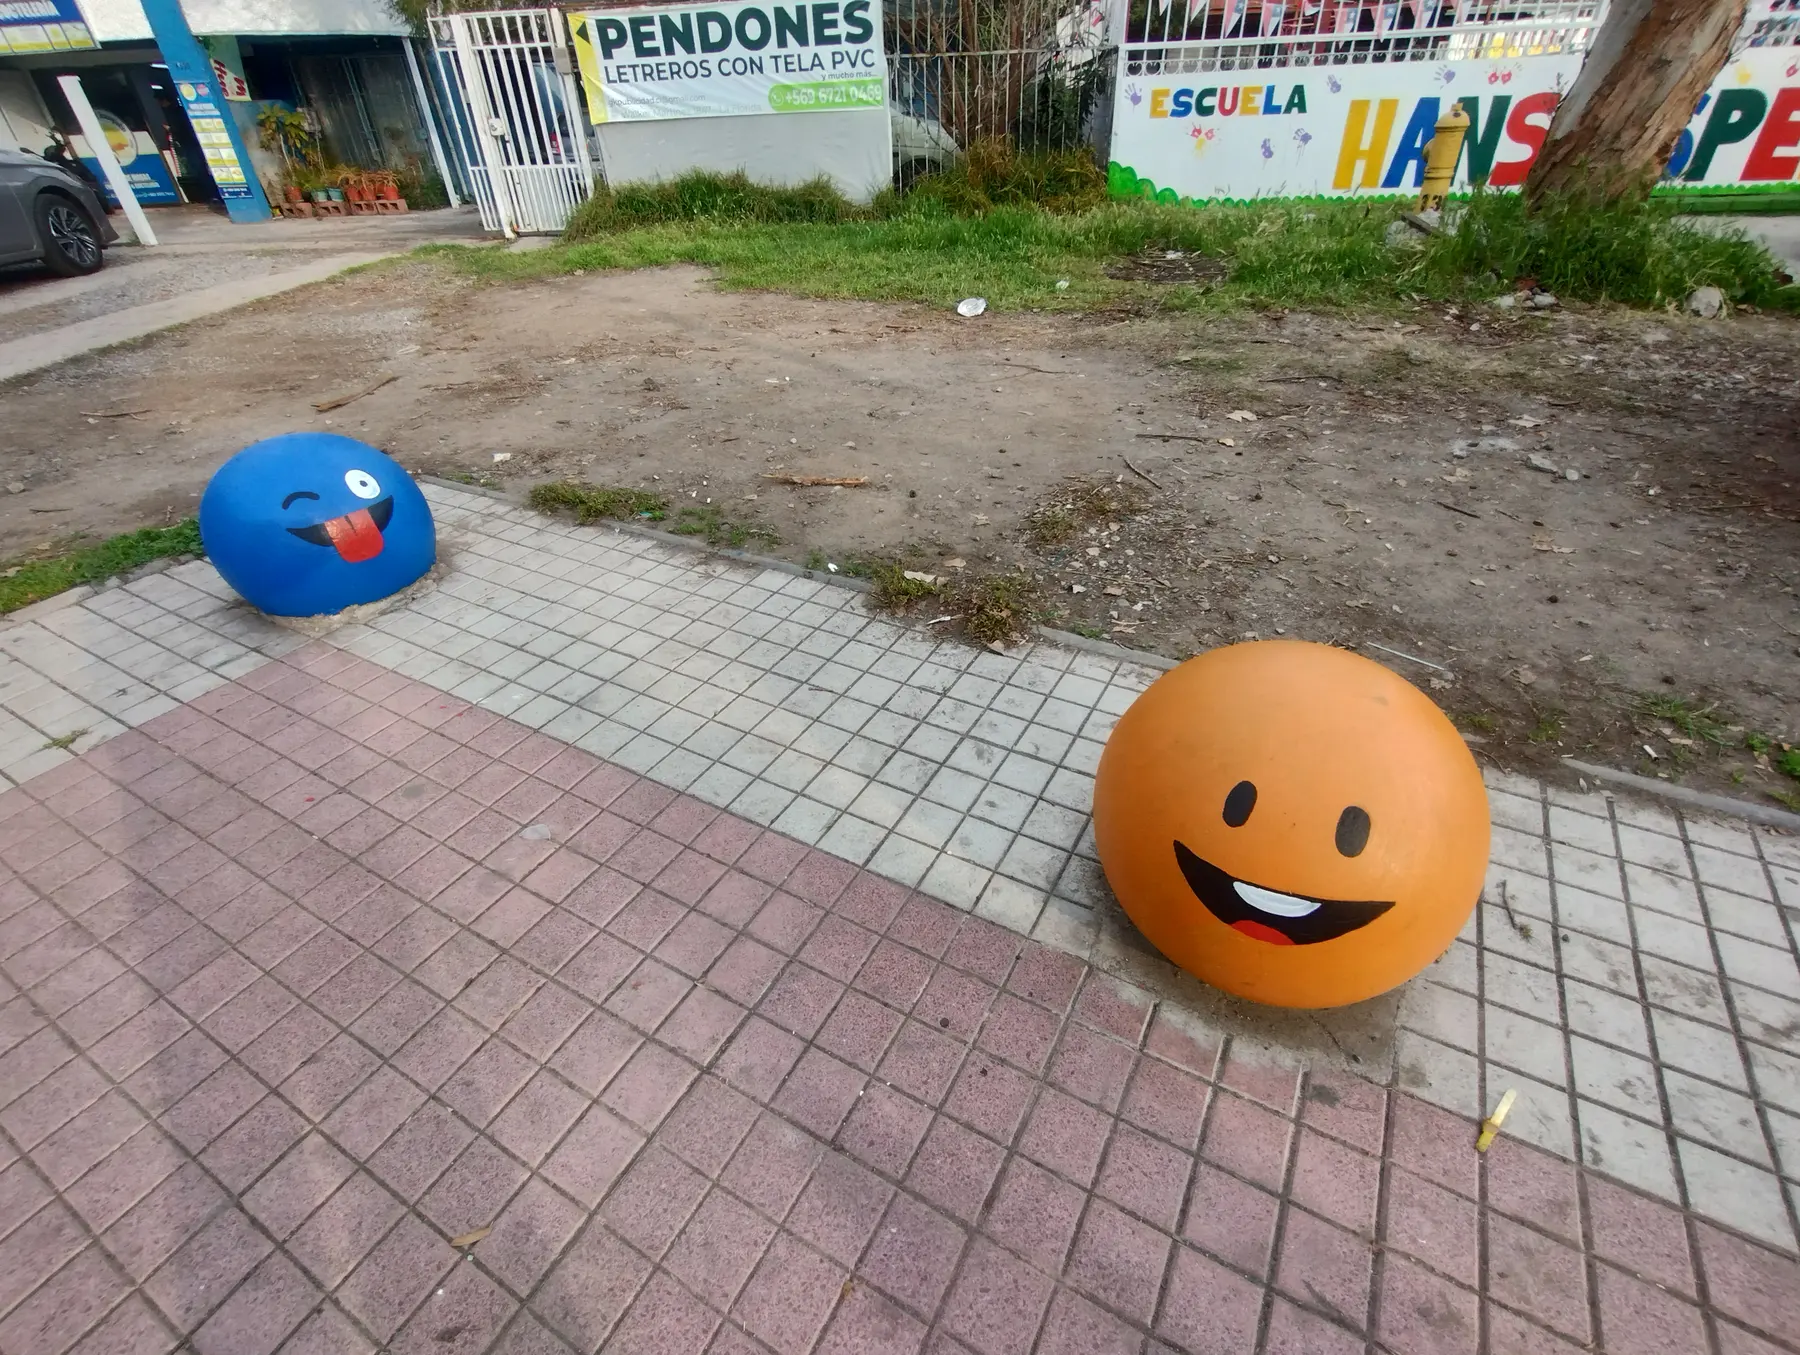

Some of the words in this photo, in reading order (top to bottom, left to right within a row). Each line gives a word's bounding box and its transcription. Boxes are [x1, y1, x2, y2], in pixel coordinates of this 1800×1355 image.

[596, 0, 874, 60] PENDONES
[604, 58, 712, 84] LETREROS
[716, 54, 764, 76] CON
[769, 51, 825, 74] TELA
[832, 48, 876, 71] PVC
[821, 74, 827, 82] y
[828, 70, 855, 79] mucho
[785, 87, 816, 105] +569
[818, 86, 848, 104] 6721
[850, 84, 883, 101] 0469
[1149, 84, 1309, 119] ESCUELA
[1332, 92, 1566, 190] HANS
[1659, 87, 1800, 181] PE
